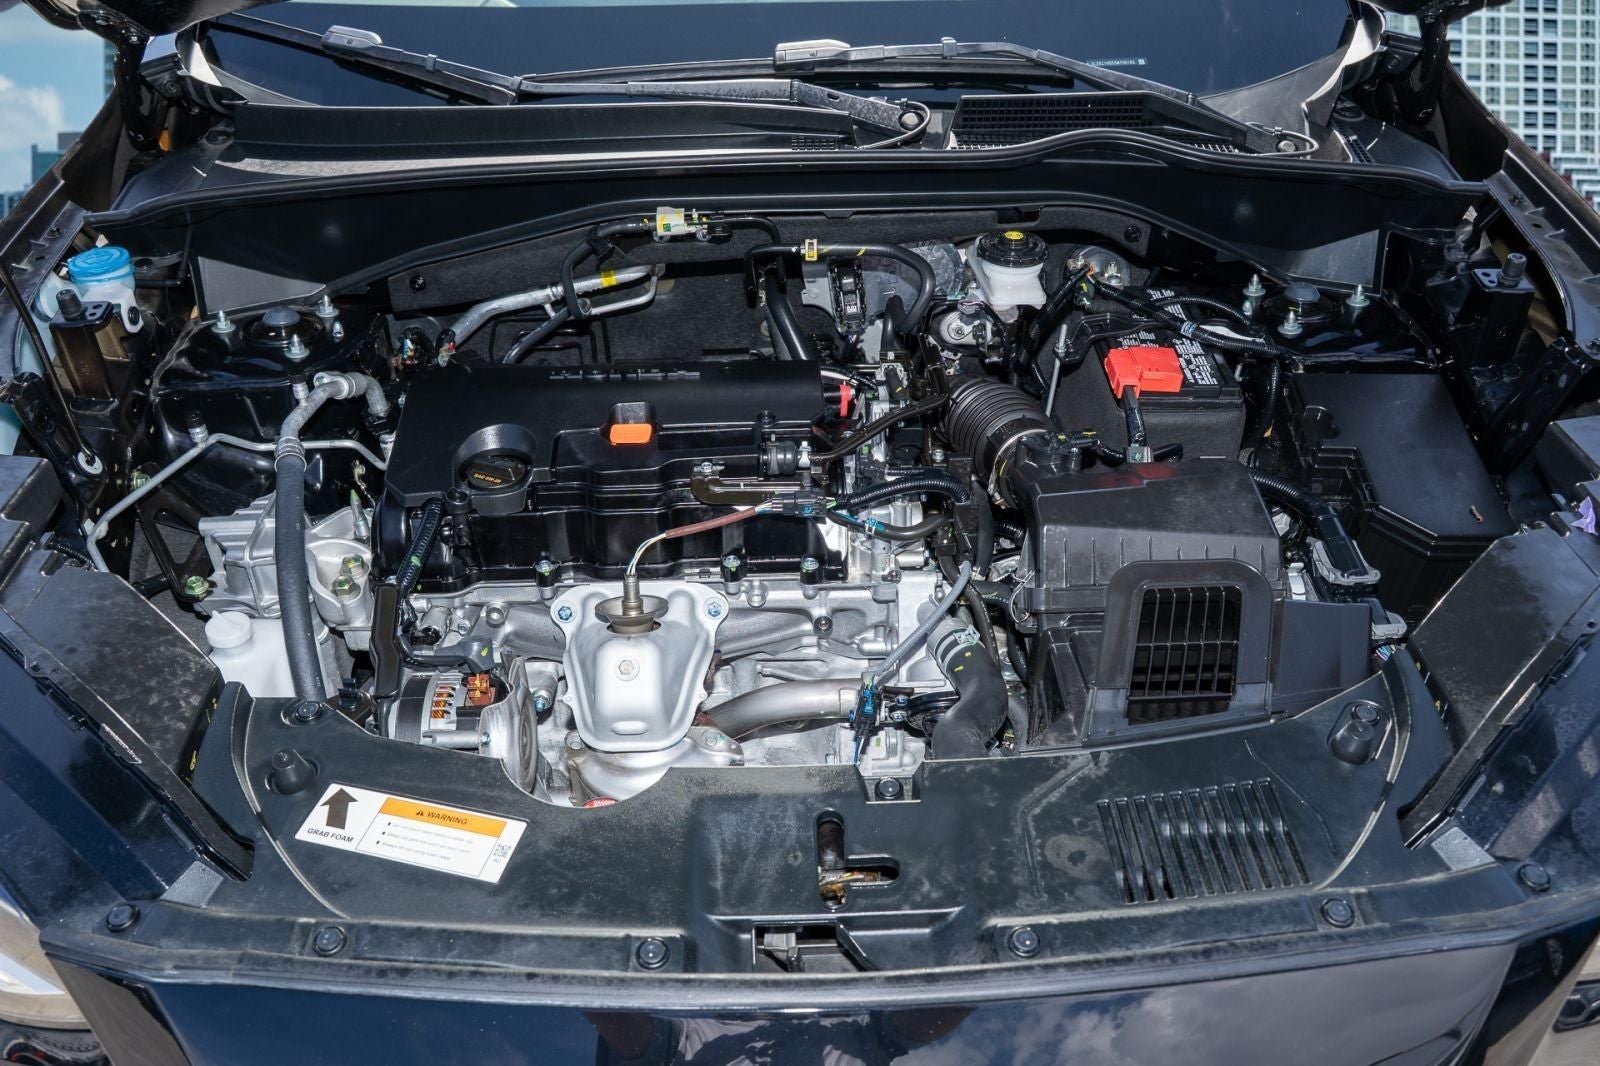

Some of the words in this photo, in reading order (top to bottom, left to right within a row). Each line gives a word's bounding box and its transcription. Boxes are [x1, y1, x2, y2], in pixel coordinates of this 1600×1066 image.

[427, 811, 468, 826] WARNING
[307, 828, 330, 838] GRAB
[330, 833, 354, 843] FOAM
